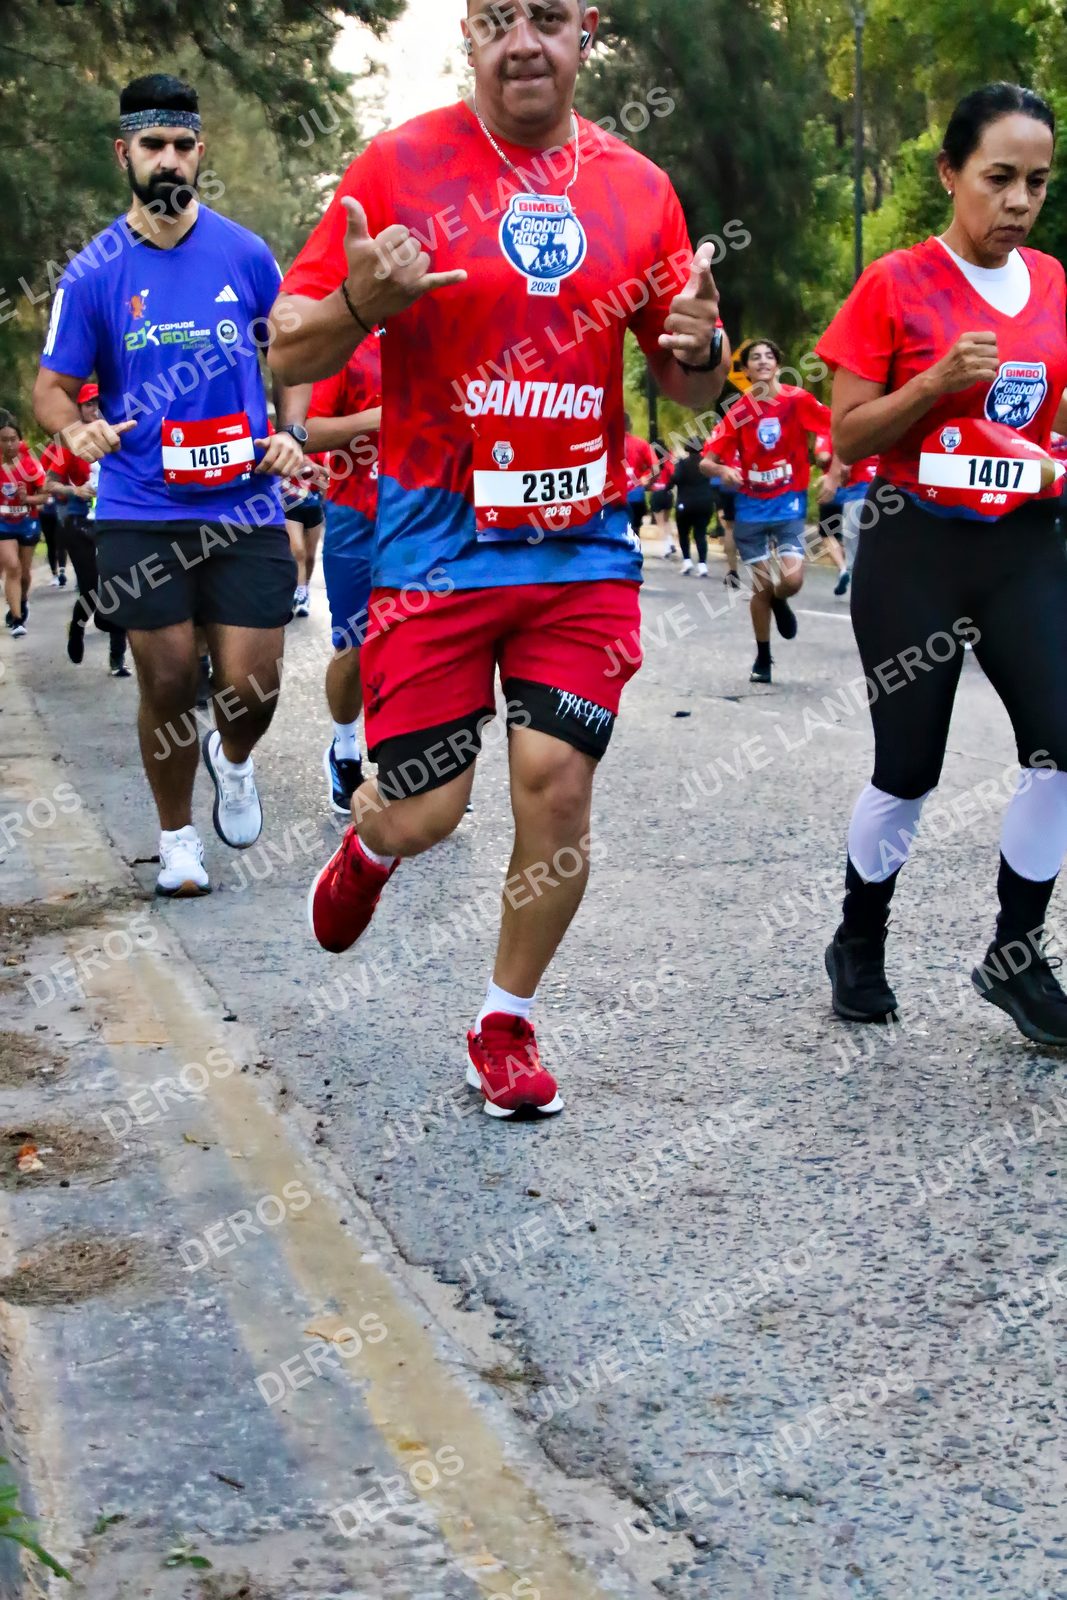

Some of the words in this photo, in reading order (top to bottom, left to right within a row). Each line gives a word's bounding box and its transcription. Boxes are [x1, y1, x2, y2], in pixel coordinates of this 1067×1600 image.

[520, 217, 565, 234] Global
[513, 229, 549, 246] Race
[530, 281, 557, 293] 2026
[160, 330, 193, 345] GDL
[1006, 369, 1040, 378] BIMBO
[1003, 381, 1037, 395] Global
[995, 392, 1022, 405] Race
[189, 444, 229, 468] 1405
[968, 458, 1024, 489] 1407
[522, 467, 589, 503] 2334
[980, 493, 1007, 505] 20-26
[544, 505, 572, 518] 20-26
